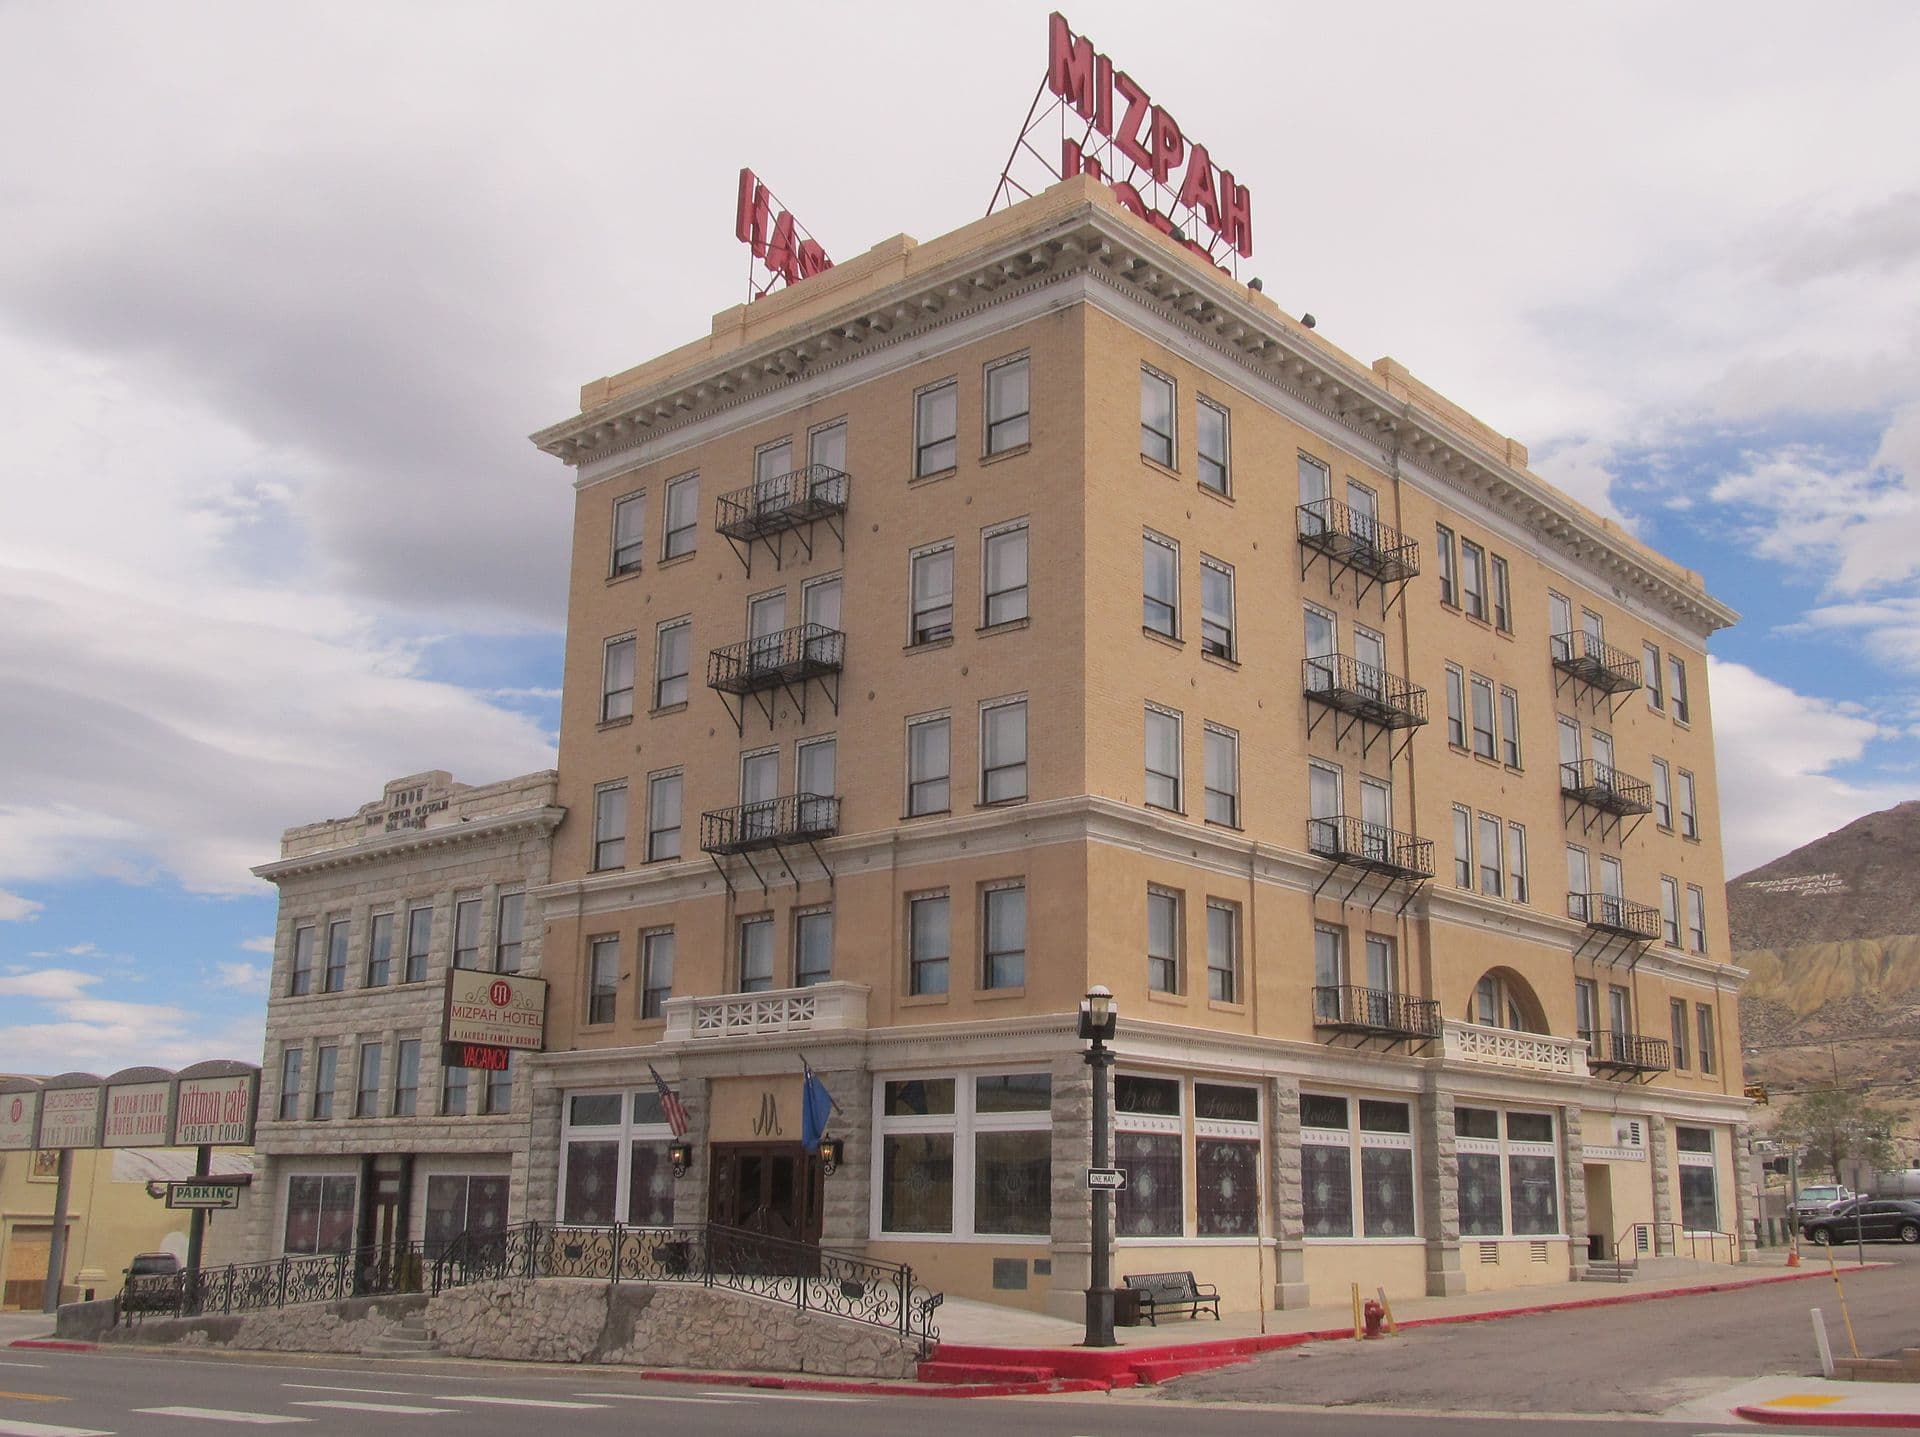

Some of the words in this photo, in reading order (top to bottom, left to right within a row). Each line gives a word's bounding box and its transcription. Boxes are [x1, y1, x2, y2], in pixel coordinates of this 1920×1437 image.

[1048, 10, 1253, 258] MIZPAH
[1747, 872, 1838, 888] TONOPAH
[451, 1005, 497, 1021] MIZPAH
[502, 1012, 543, 1026] HOTEL
[490, 1035, 513, 1043] FAMILY
[463, 1047, 508, 1070] VACANCY
[180, 1085, 221, 1133] pittman
[224, 1079, 247, 1123] cafe
[184, 1126, 214, 1142] GREAT
[219, 1124, 244, 1141] FOOD
[1092, 1174, 1103, 1183] ONE
[1103, 1175, 1115, 1184] WAY
[176, 1187, 234, 1199] PARKING
